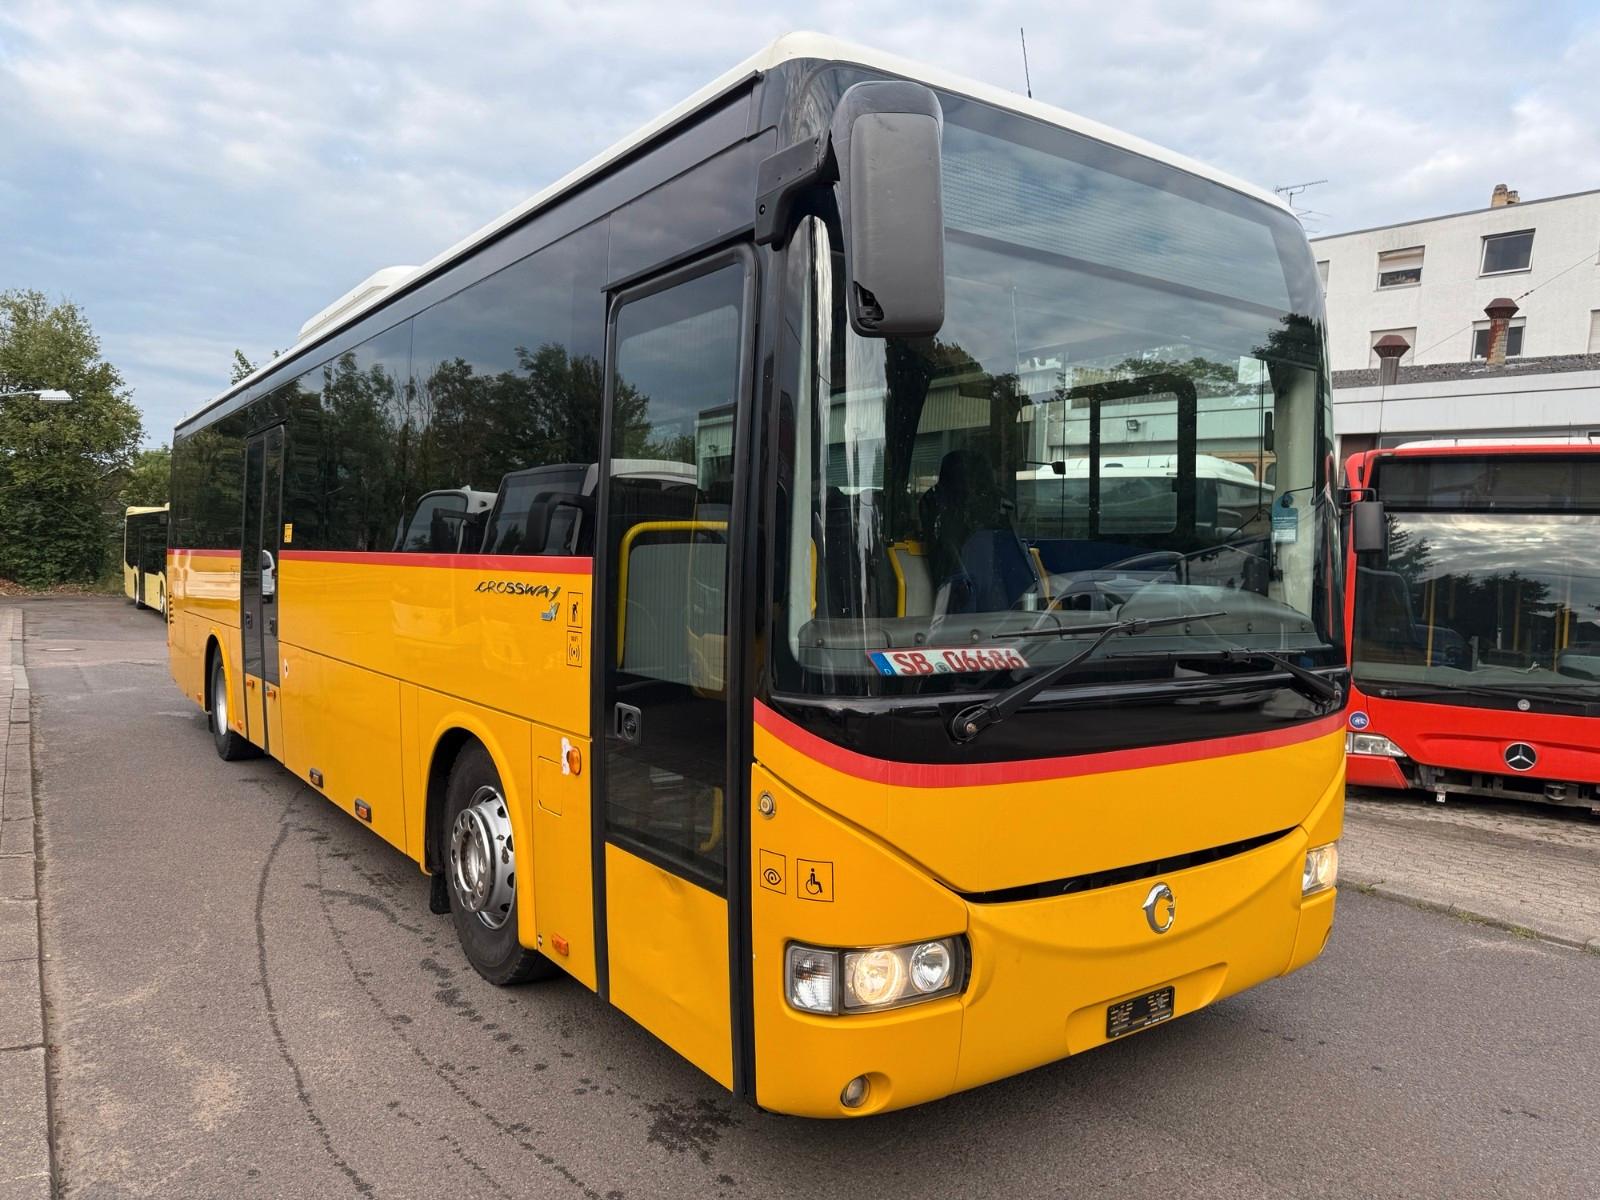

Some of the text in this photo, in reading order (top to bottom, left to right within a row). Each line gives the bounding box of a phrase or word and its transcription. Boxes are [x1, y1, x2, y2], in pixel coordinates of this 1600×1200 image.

[474, 580, 561, 602] CROSSWAY
[892, 652, 934, 675] SB
[942, 650, 1025, 673] 06686
